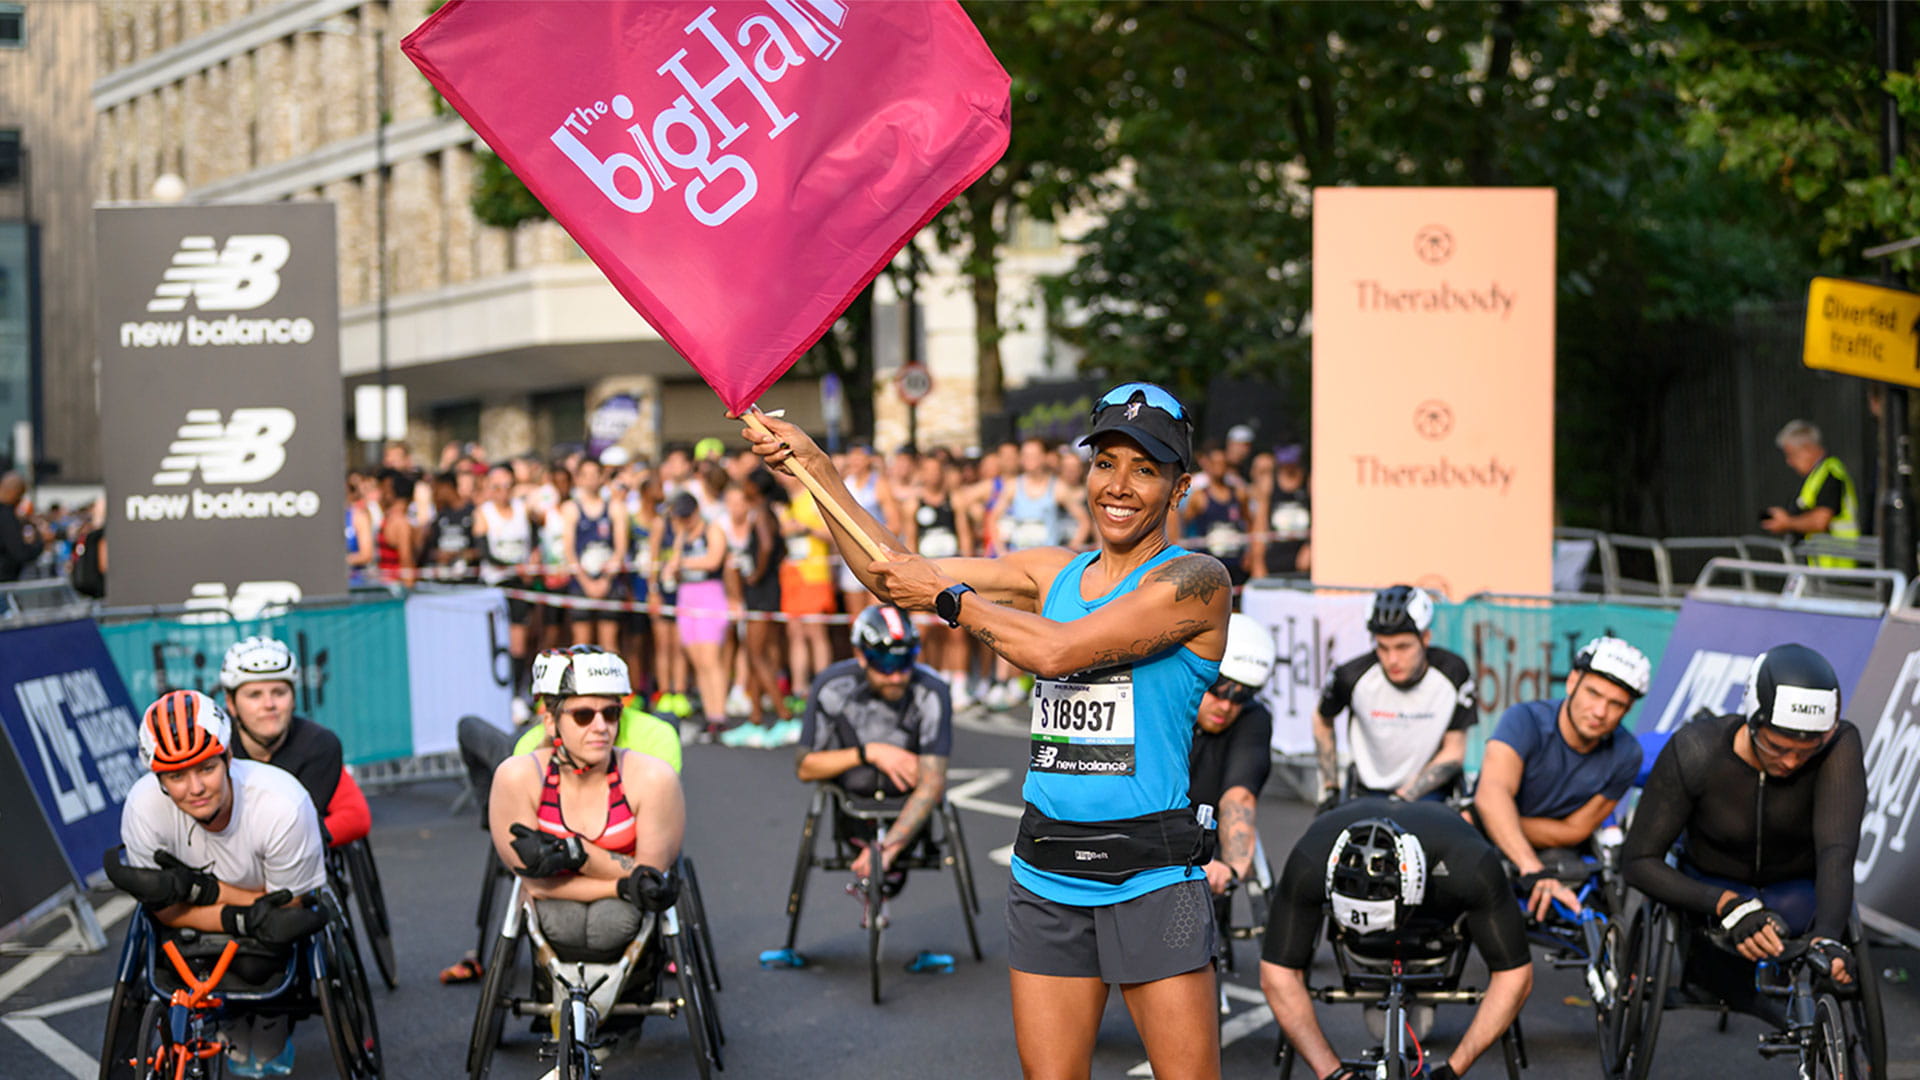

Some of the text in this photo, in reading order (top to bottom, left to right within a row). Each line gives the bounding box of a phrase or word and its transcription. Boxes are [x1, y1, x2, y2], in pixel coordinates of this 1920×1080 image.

[564, 99, 609, 135] The
[1353, 279, 1516, 321] Therabody
[1823, 294, 1897, 333] Diverted
[121, 316, 314, 348] new balance
[1352, 454, 1516, 496] Therabody
[126, 489, 320, 521] new balance
[1053, 699, 1116, 733] 18937
[1791, 703, 1827, 716] SMITH
[1056, 760, 1078, 770] new
[1079, 759, 1128, 771] balance
[1351, 909, 1369, 927] 81
